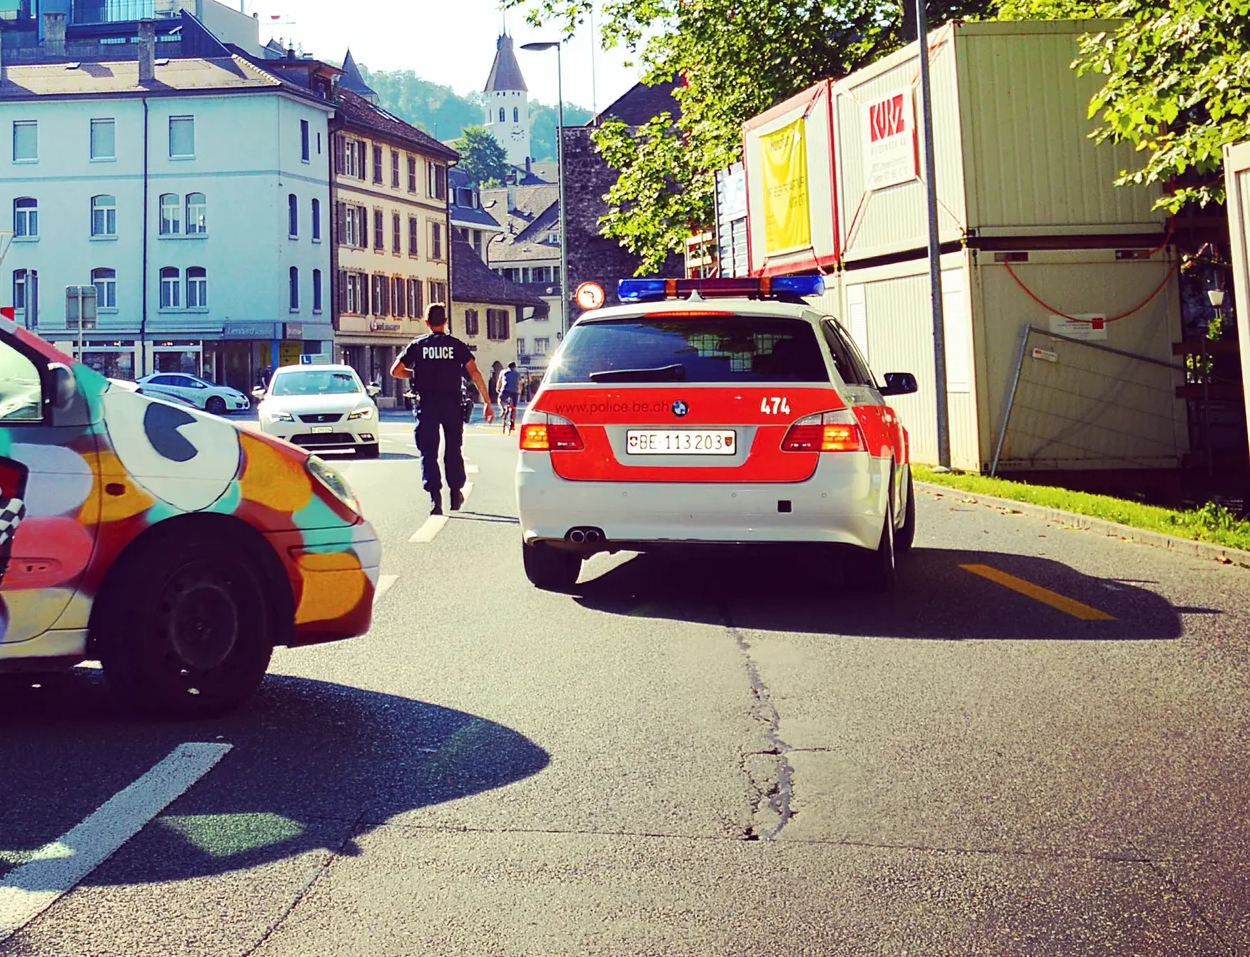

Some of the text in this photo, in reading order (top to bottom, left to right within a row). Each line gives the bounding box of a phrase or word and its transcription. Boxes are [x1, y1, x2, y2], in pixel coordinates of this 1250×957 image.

[869, 94, 905, 142] KURZ
[422, 346, 455, 359] POLICE
[555, 401, 670, 415] www.police.be.ch
[760, 397, 791, 415] 474
[639, 434, 657, 449] BE
